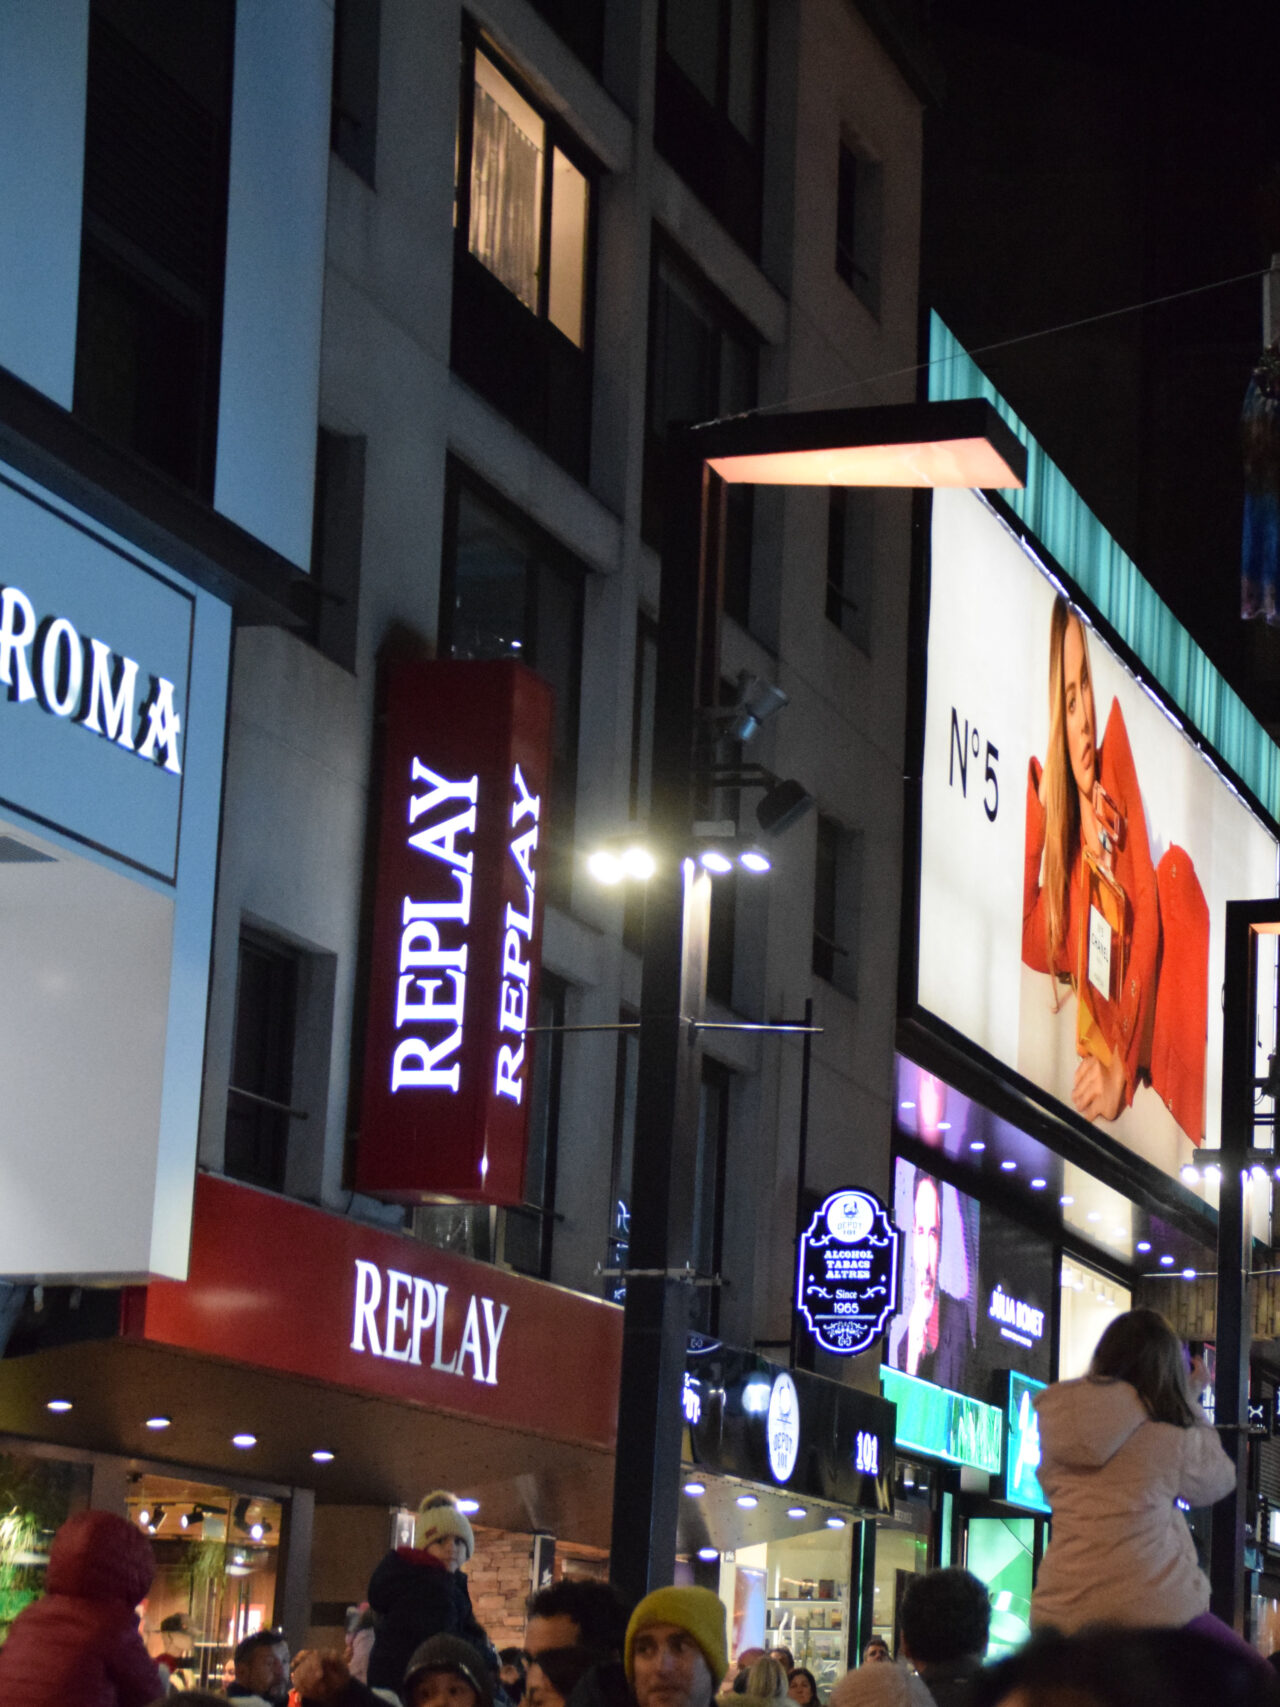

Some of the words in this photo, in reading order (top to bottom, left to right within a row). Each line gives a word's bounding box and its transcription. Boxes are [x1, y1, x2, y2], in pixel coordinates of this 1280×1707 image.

[0, 587, 182, 774] ROMA
[390, 757, 479, 1095] REPLAY
[495, 763, 541, 1105] REPLAY
[824, 1250, 874, 1259] ALCOHOL
[826, 1260, 871, 1269] TABACS
[825, 1270, 871, 1279] ALTRES
[835, 1289, 858, 1299] Since
[833, 1302, 859, 1314] 1965
[349, 1258, 509, 1386] REPLAY
[857, 1431, 878, 1474] 101
